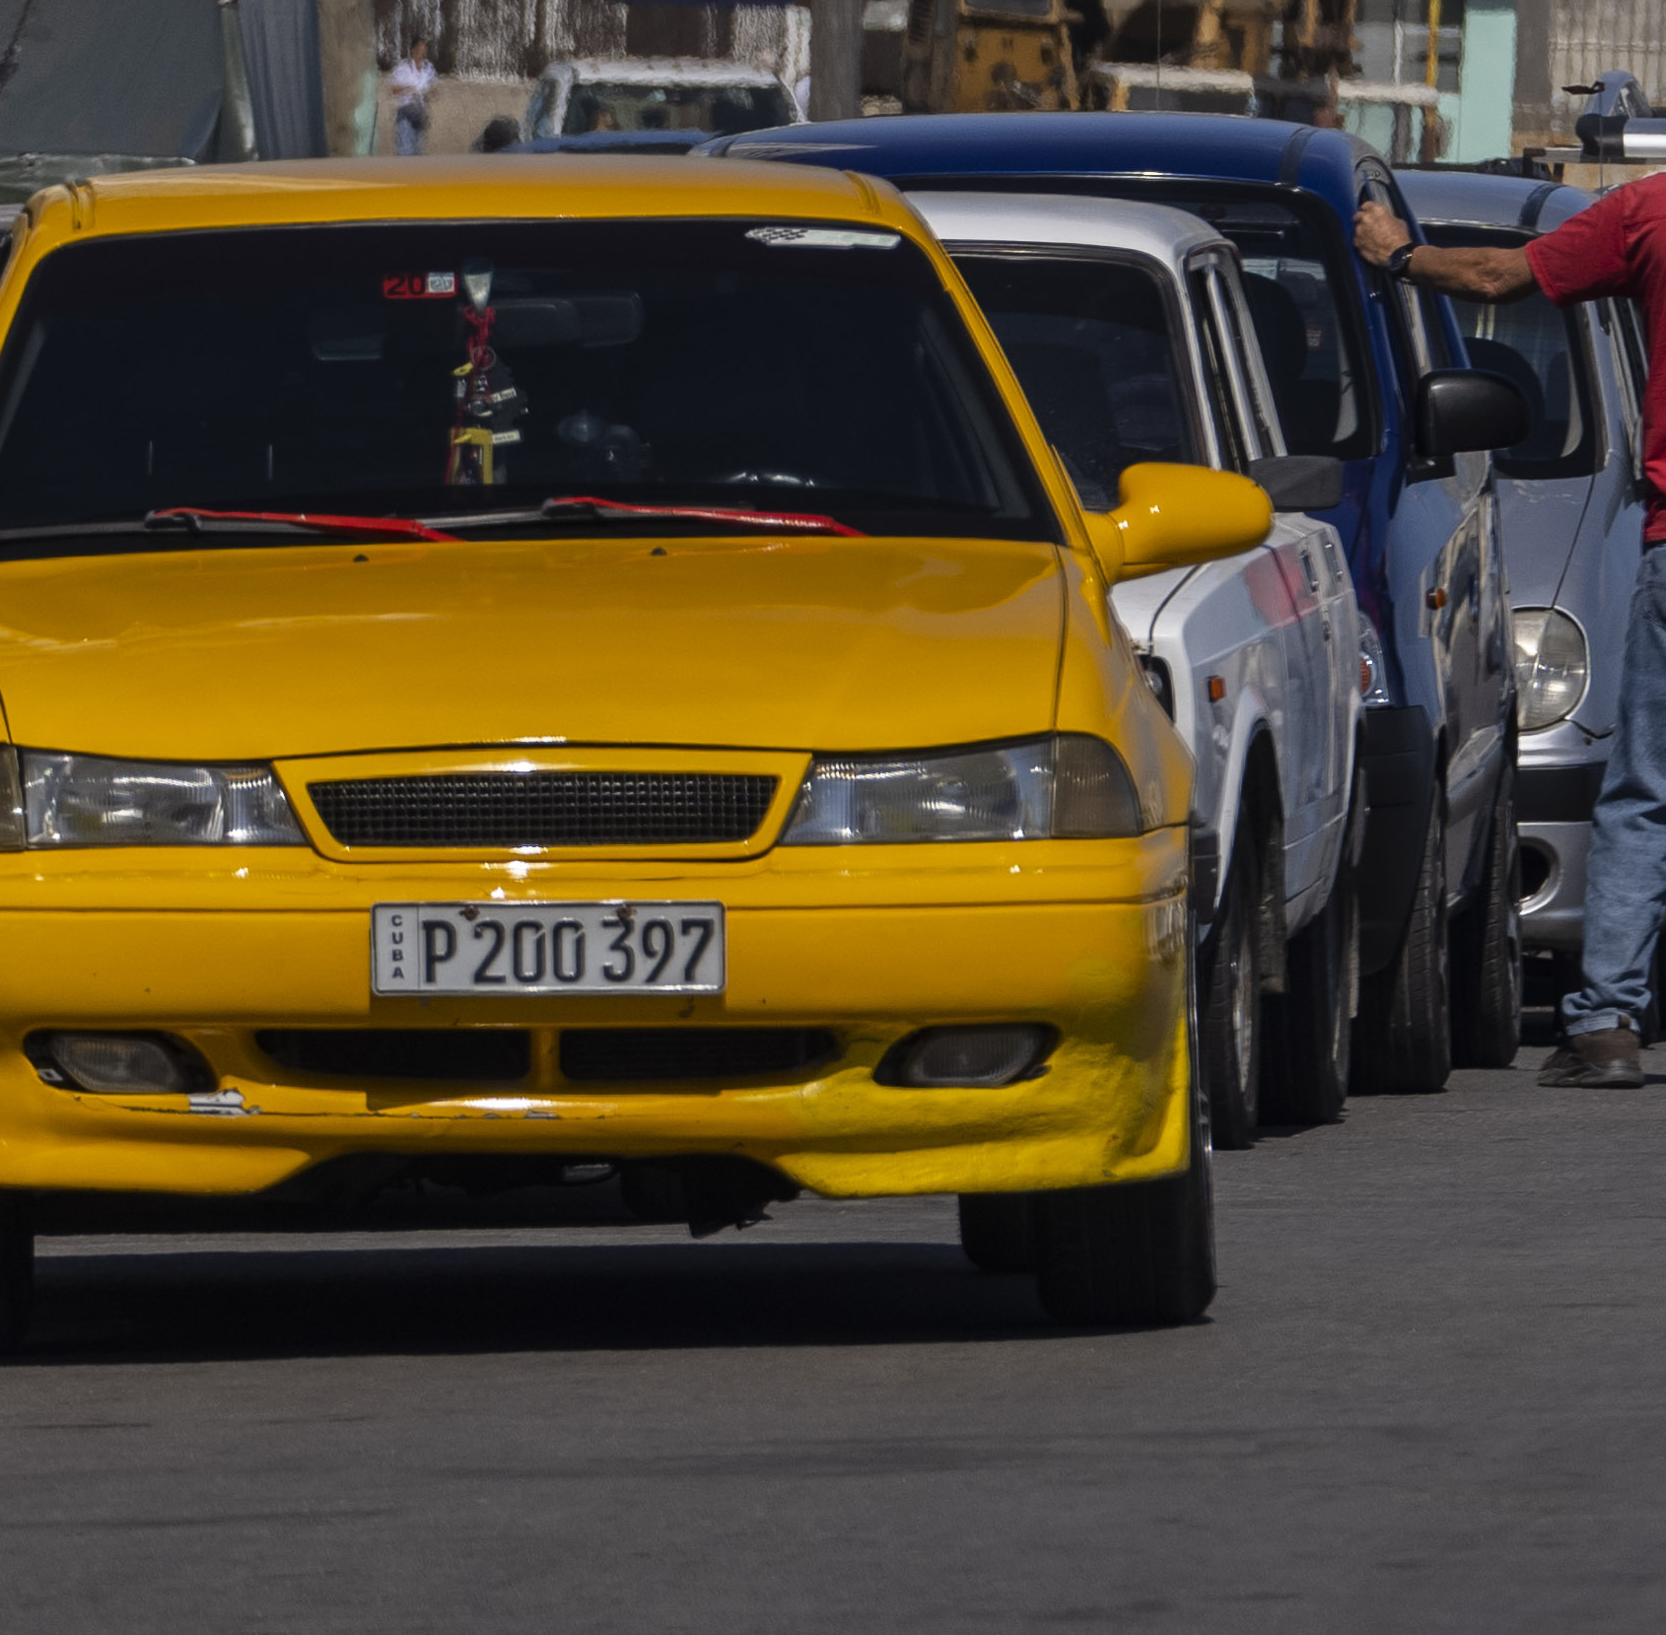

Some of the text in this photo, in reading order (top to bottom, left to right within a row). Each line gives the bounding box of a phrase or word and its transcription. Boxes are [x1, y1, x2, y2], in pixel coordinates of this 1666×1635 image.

[390, 914, 405, 981] CUBA
[422, 917, 716, 984] P 200 397
